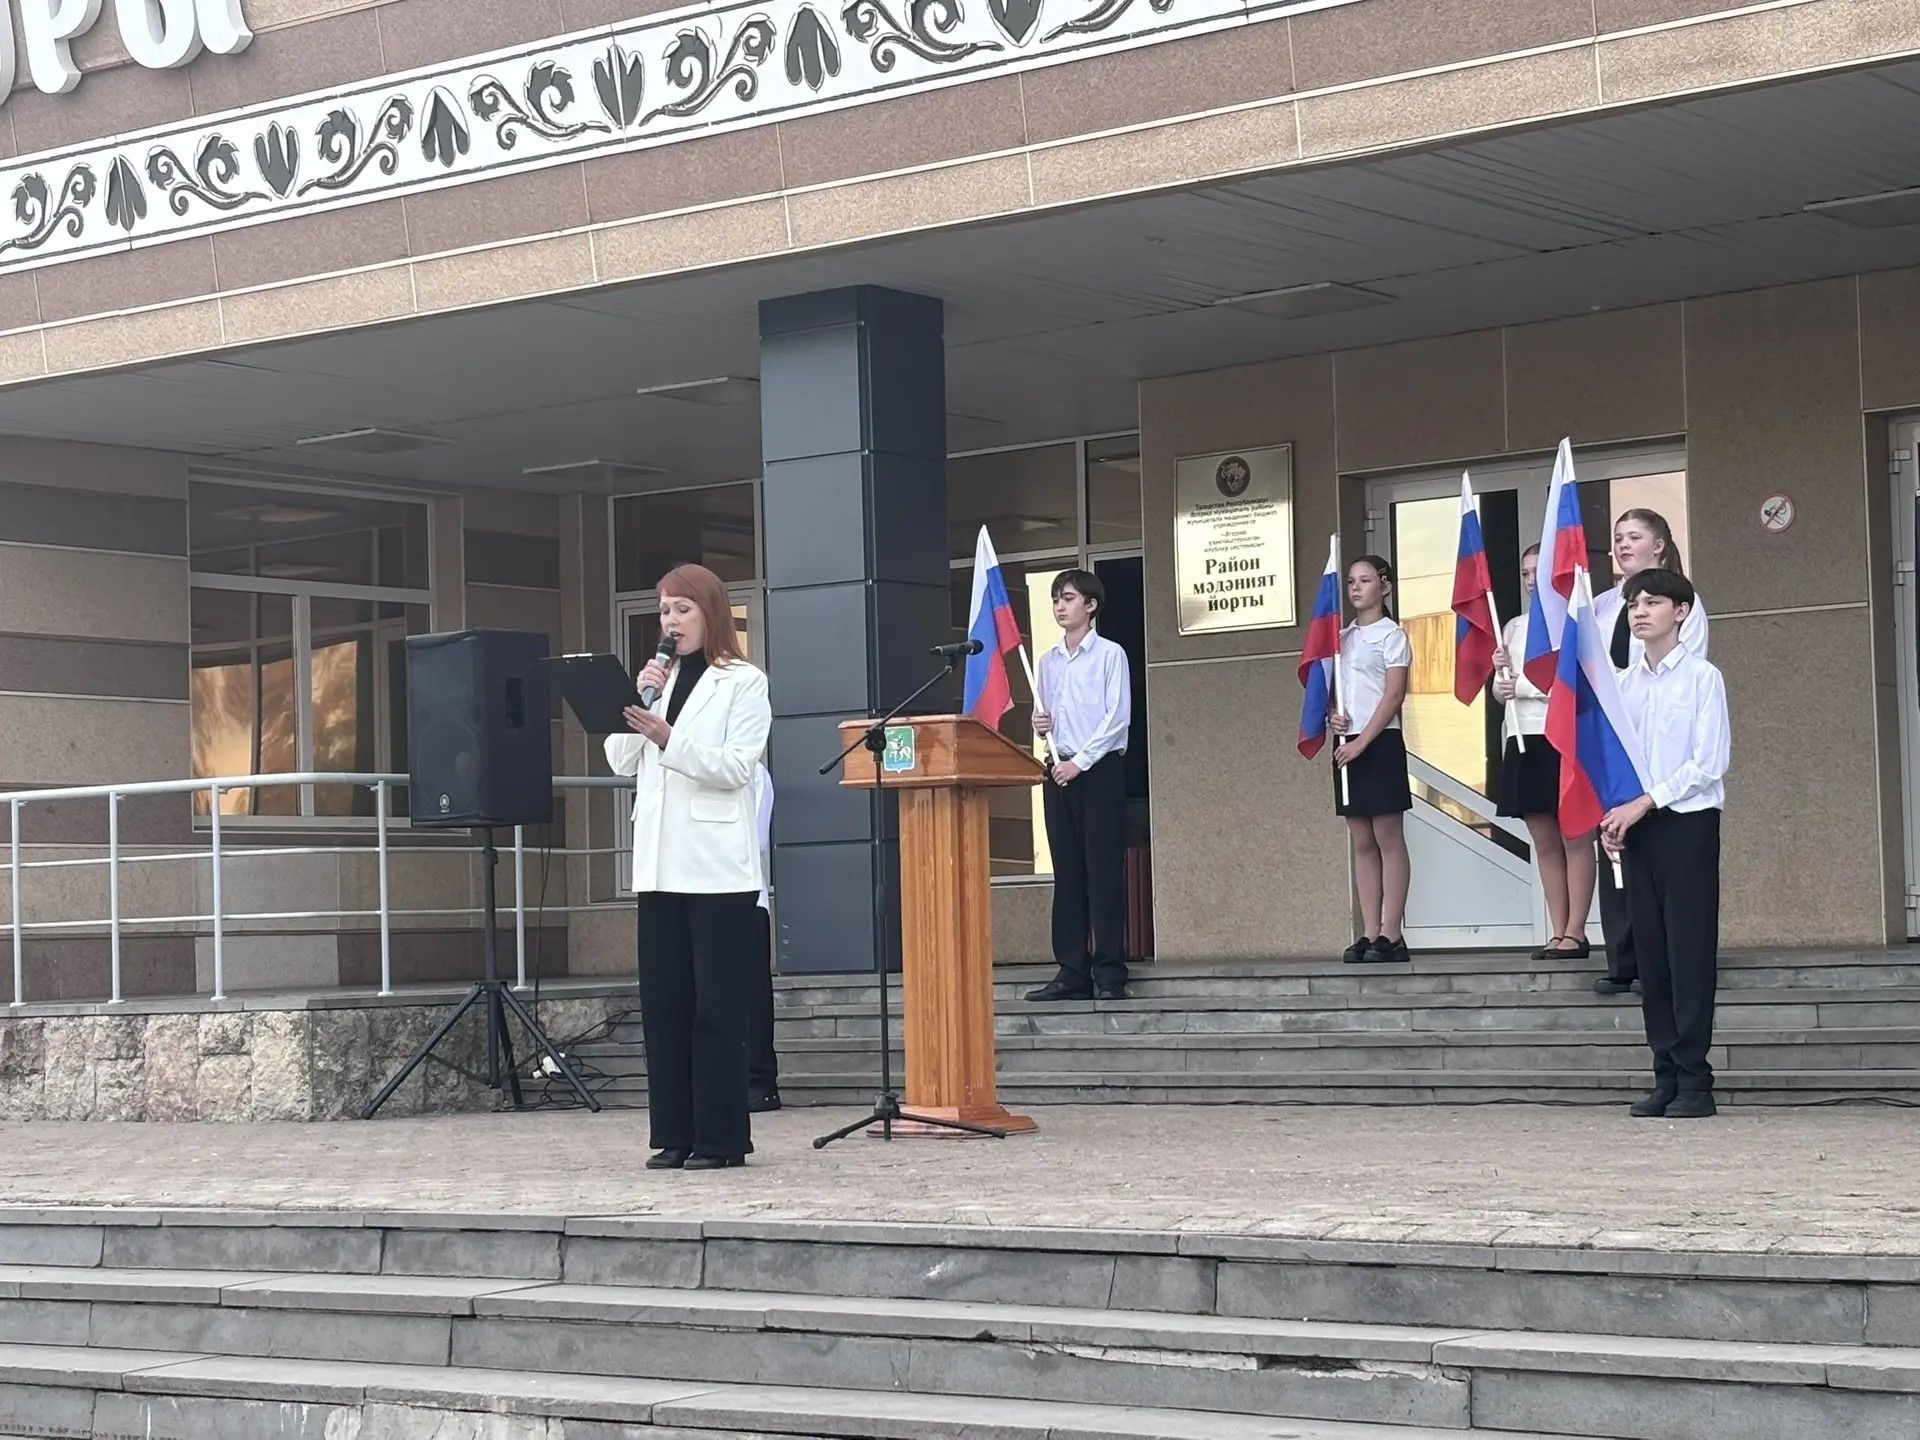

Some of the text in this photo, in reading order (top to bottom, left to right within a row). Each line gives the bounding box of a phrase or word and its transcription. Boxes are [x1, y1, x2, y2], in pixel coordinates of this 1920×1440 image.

[1205, 556, 1260, 575] Район
[1193, 574, 1277, 595] мәдәният
[1208, 594, 1264, 613] йорты
